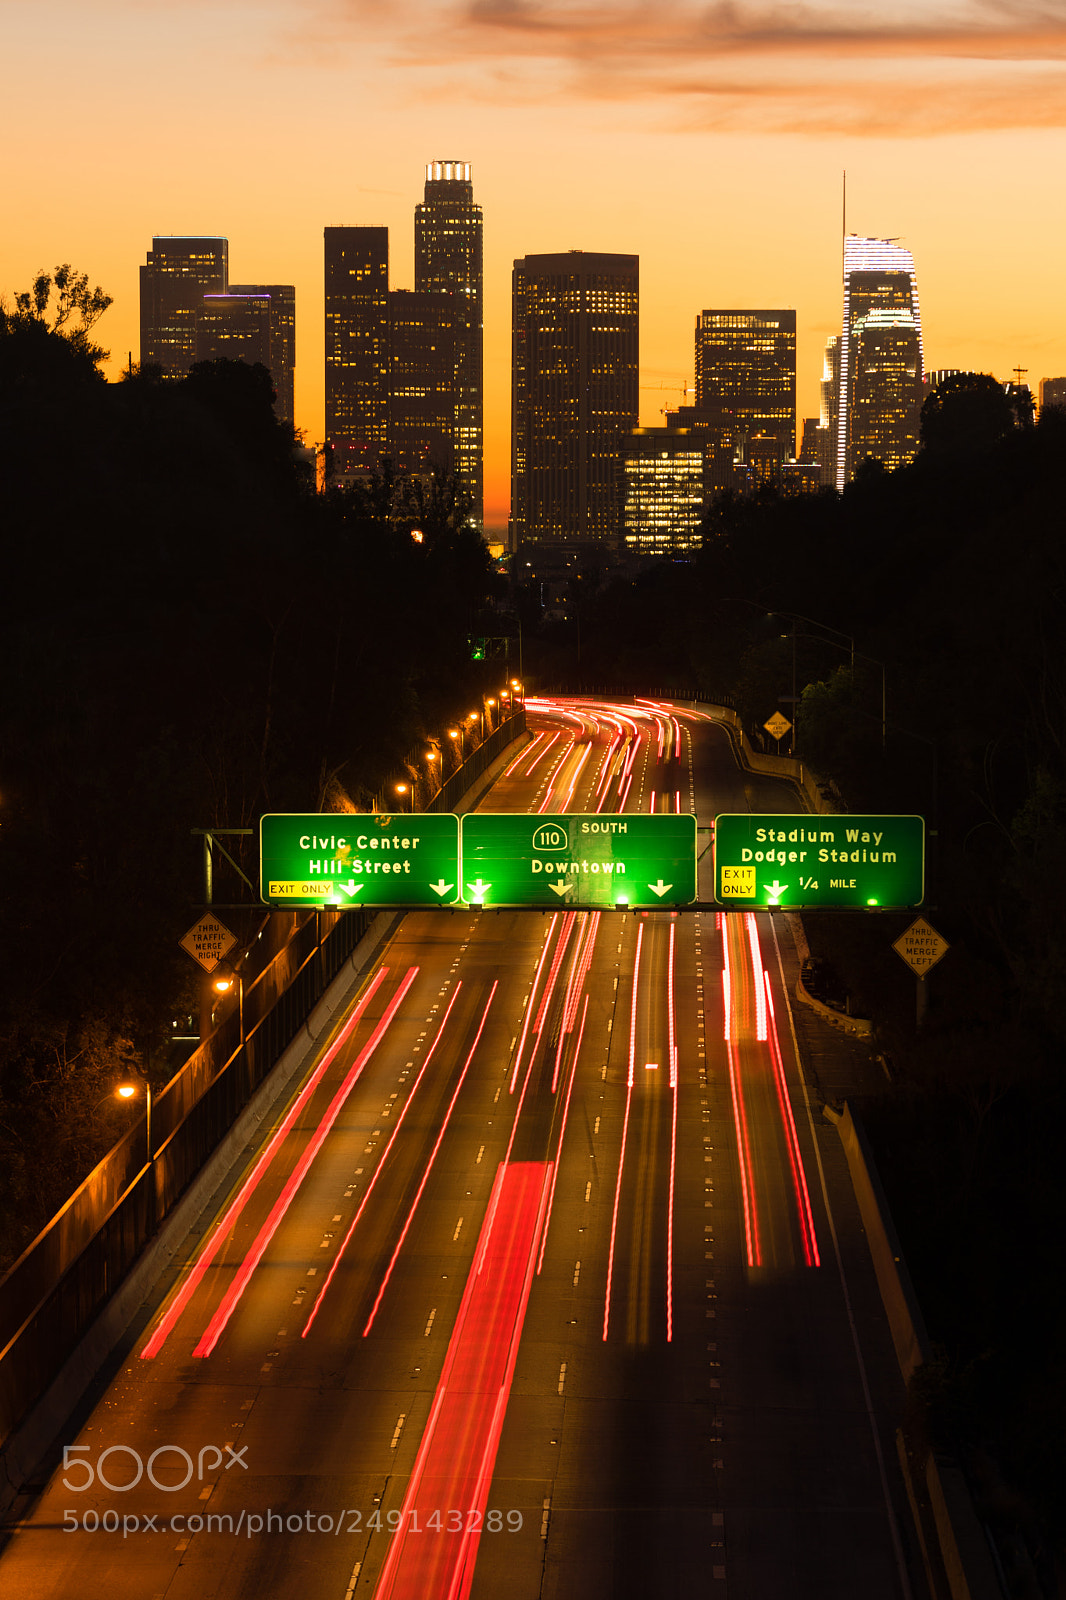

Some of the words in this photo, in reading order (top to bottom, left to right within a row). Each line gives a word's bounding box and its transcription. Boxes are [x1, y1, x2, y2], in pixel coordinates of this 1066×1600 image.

[581, 823, 628, 834] SOUTH
[540, 832, 560, 846] 110
[755, 828, 835, 843] Stadium
[845, 828, 884, 846] Way
[299, 835, 347, 850] Civic
[356, 835, 420, 850] Center
[741, 848, 808, 866] Dodger
[818, 848, 897, 863] Stadium
[309, 859, 342, 874] Hill
[351, 859, 411, 874] Street
[531, 859, 626, 874] Downtown
[723, 869, 753, 879] EXIT
[829, 878, 857, 889] MILE
[270, 884, 295, 894] EXIT
[301, 884, 331, 894] ONLY
[723, 884, 753, 894] ONLY
[197, 924, 220, 932] THRU
[911, 927, 932, 936] THRU
[192, 933, 226, 941] TRAFFIC
[904, 937, 938, 946] TRAFFIC
[195, 942, 222, 950] MERGE
[198, 951, 221, 960] RIGHT
[906, 947, 937, 956] MERGE
[910, 957, 933, 965] LEFT
